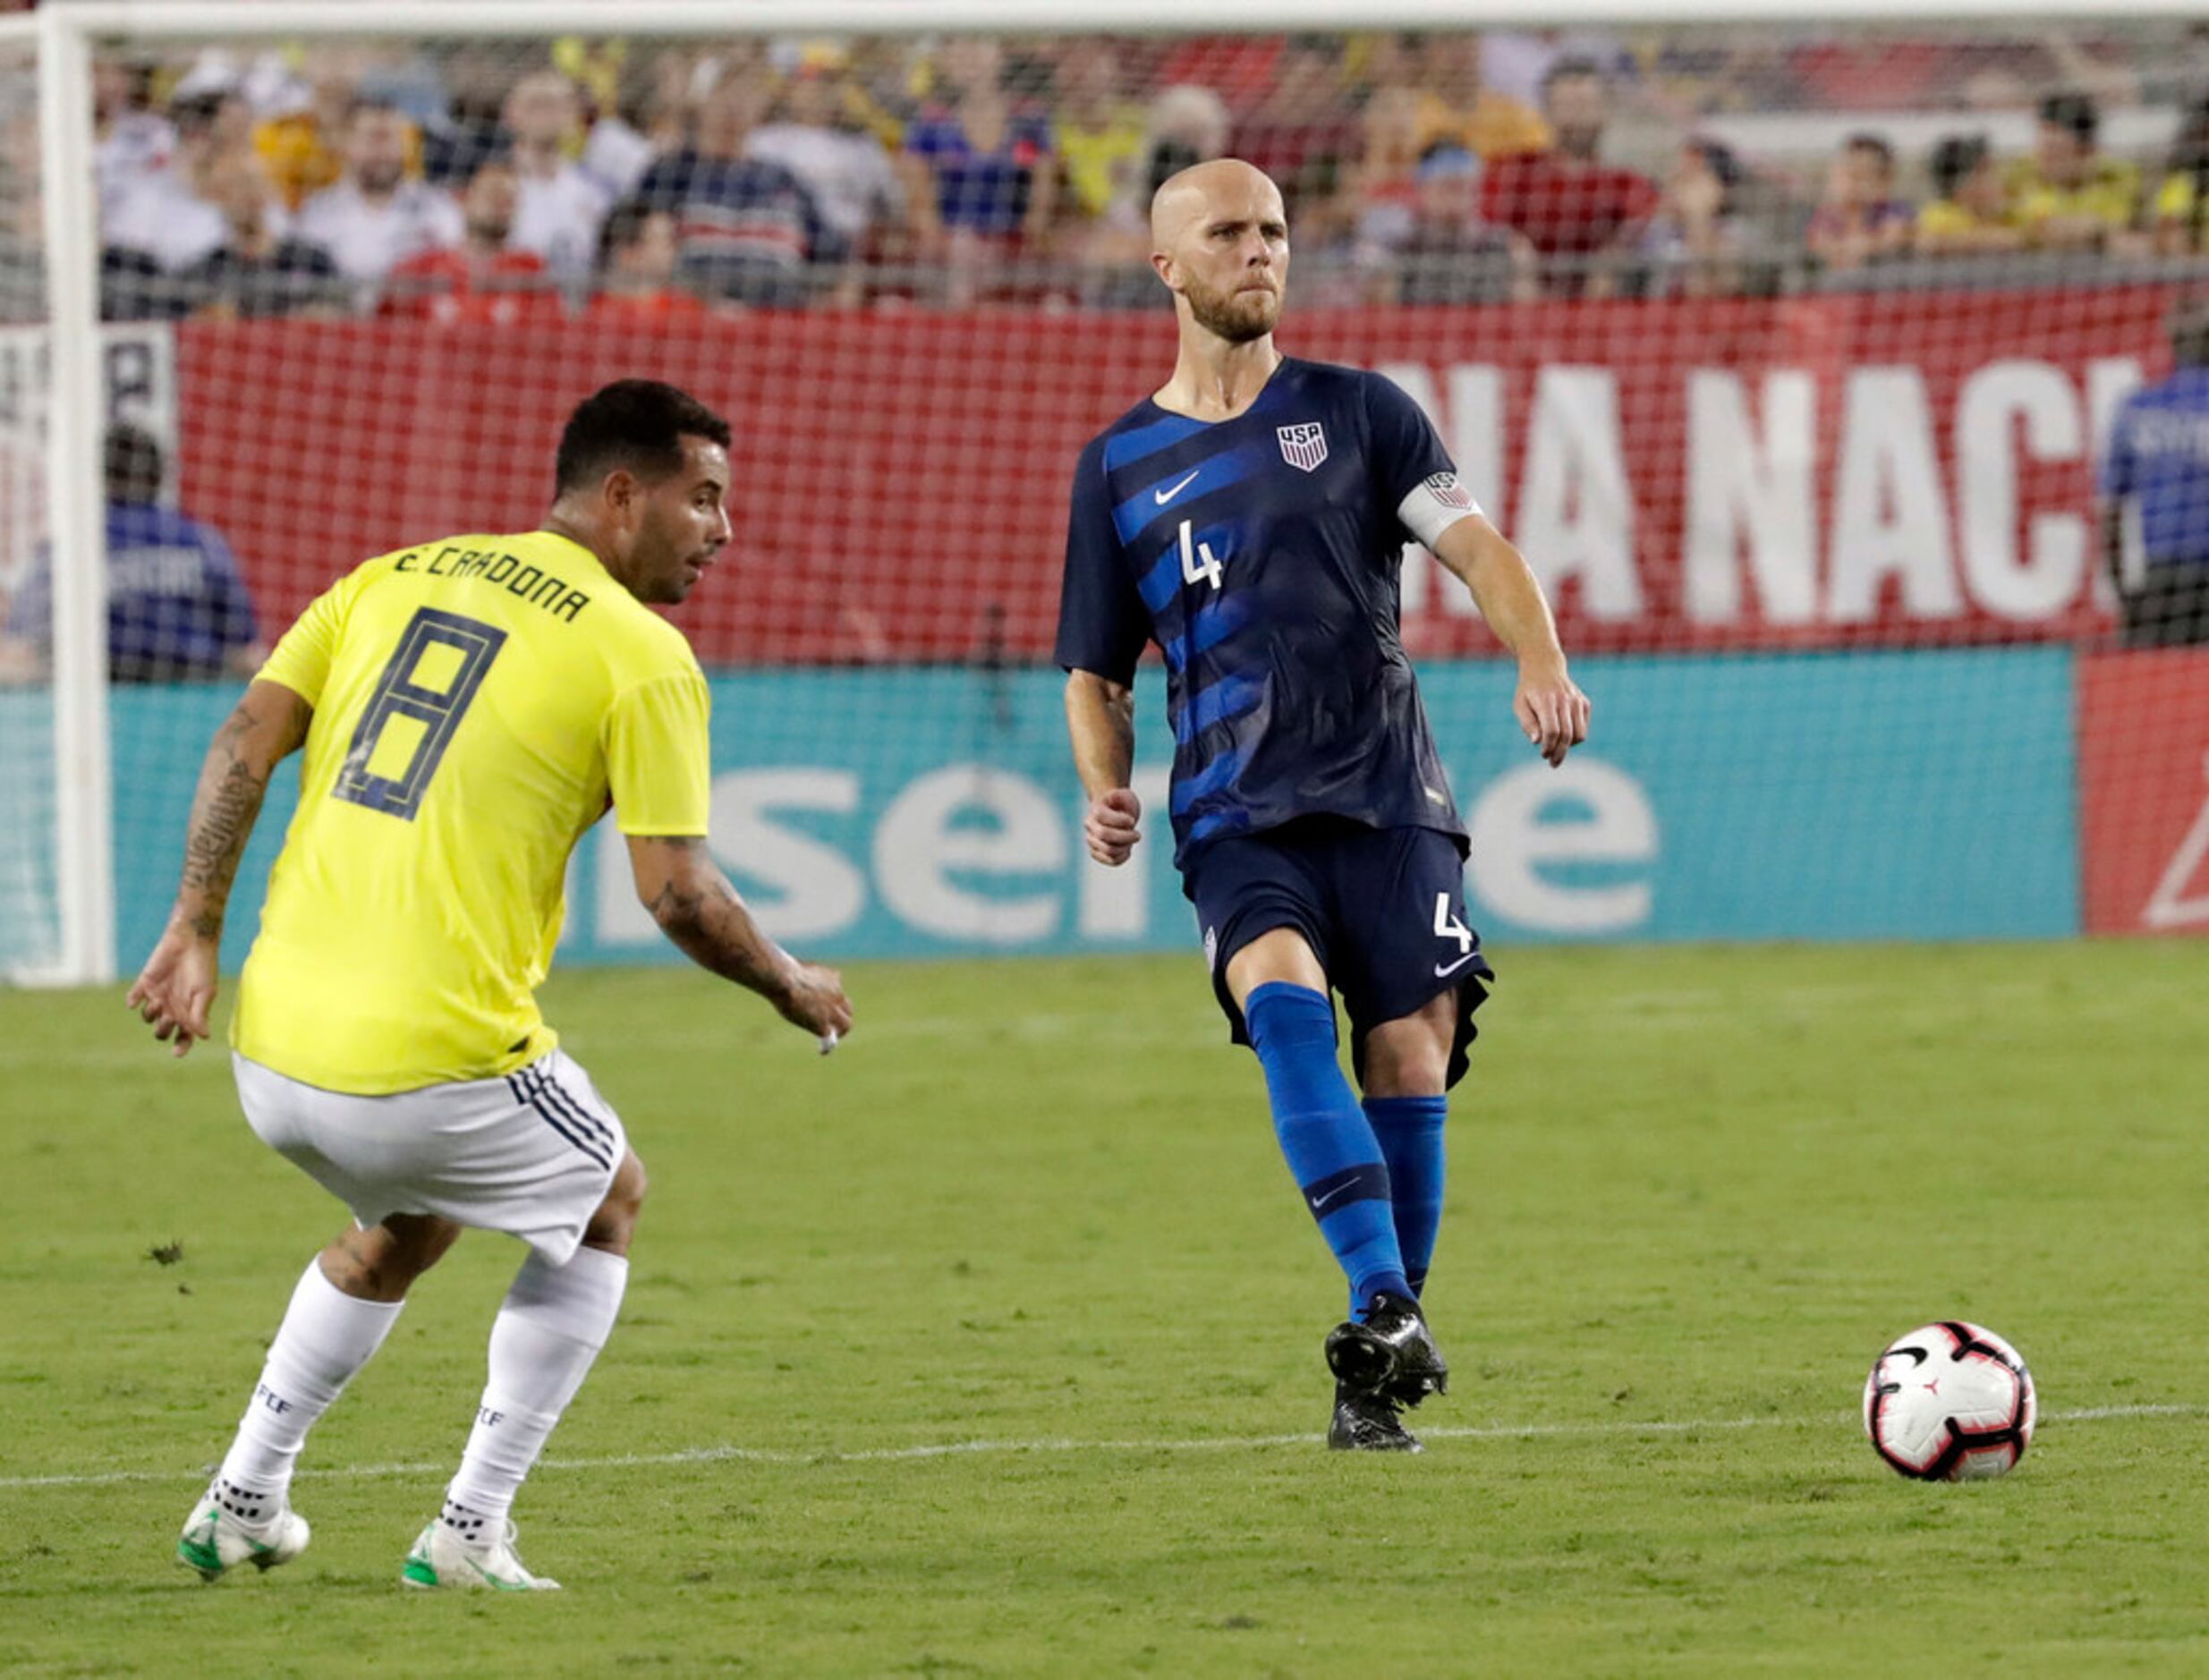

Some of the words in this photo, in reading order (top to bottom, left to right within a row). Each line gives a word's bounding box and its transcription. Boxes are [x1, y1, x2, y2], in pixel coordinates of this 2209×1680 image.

[1280, 424, 1320, 445] USA
[1424, 473, 1455, 488] US
[1179, 520, 1223, 590] 4
[331, 606, 508, 822] 8
[1434, 892, 1473, 954] 4
[477, 1405, 506, 1426] CF
